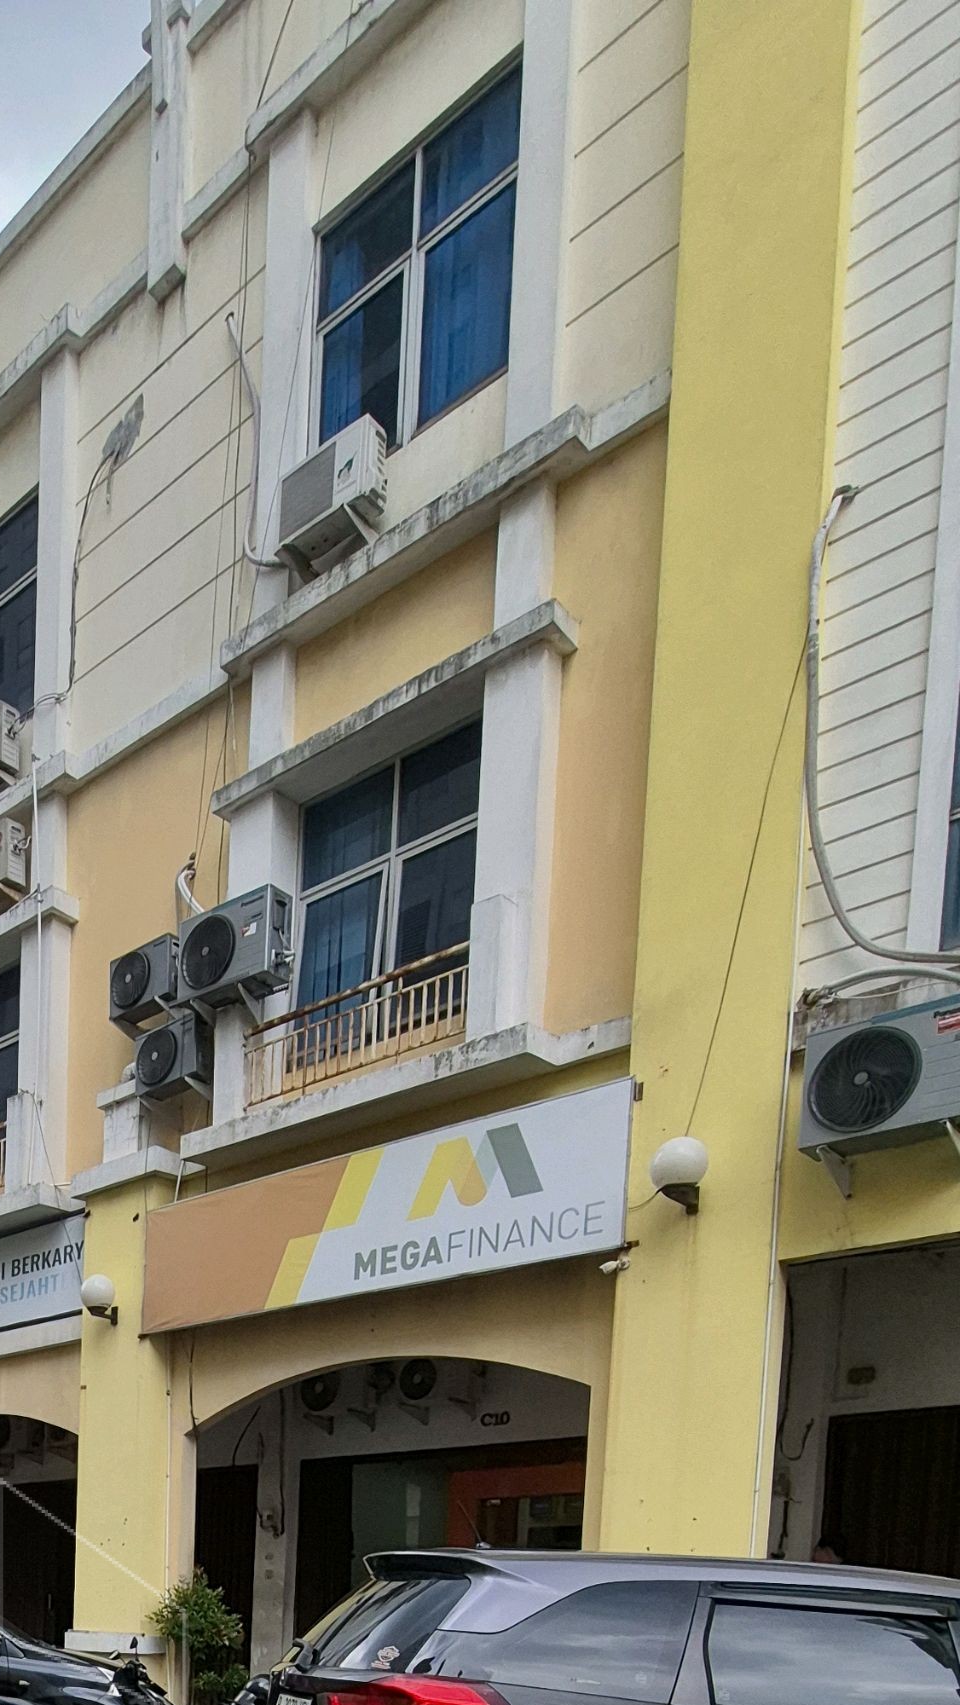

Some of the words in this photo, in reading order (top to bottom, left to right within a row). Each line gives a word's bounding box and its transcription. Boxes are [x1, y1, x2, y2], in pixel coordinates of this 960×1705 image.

[353, 1200, 606, 1281] MEGAFINANCE
[0, 1272, 65, 1304] SEJAHT
[480, 1411, 511, 1427] C10
